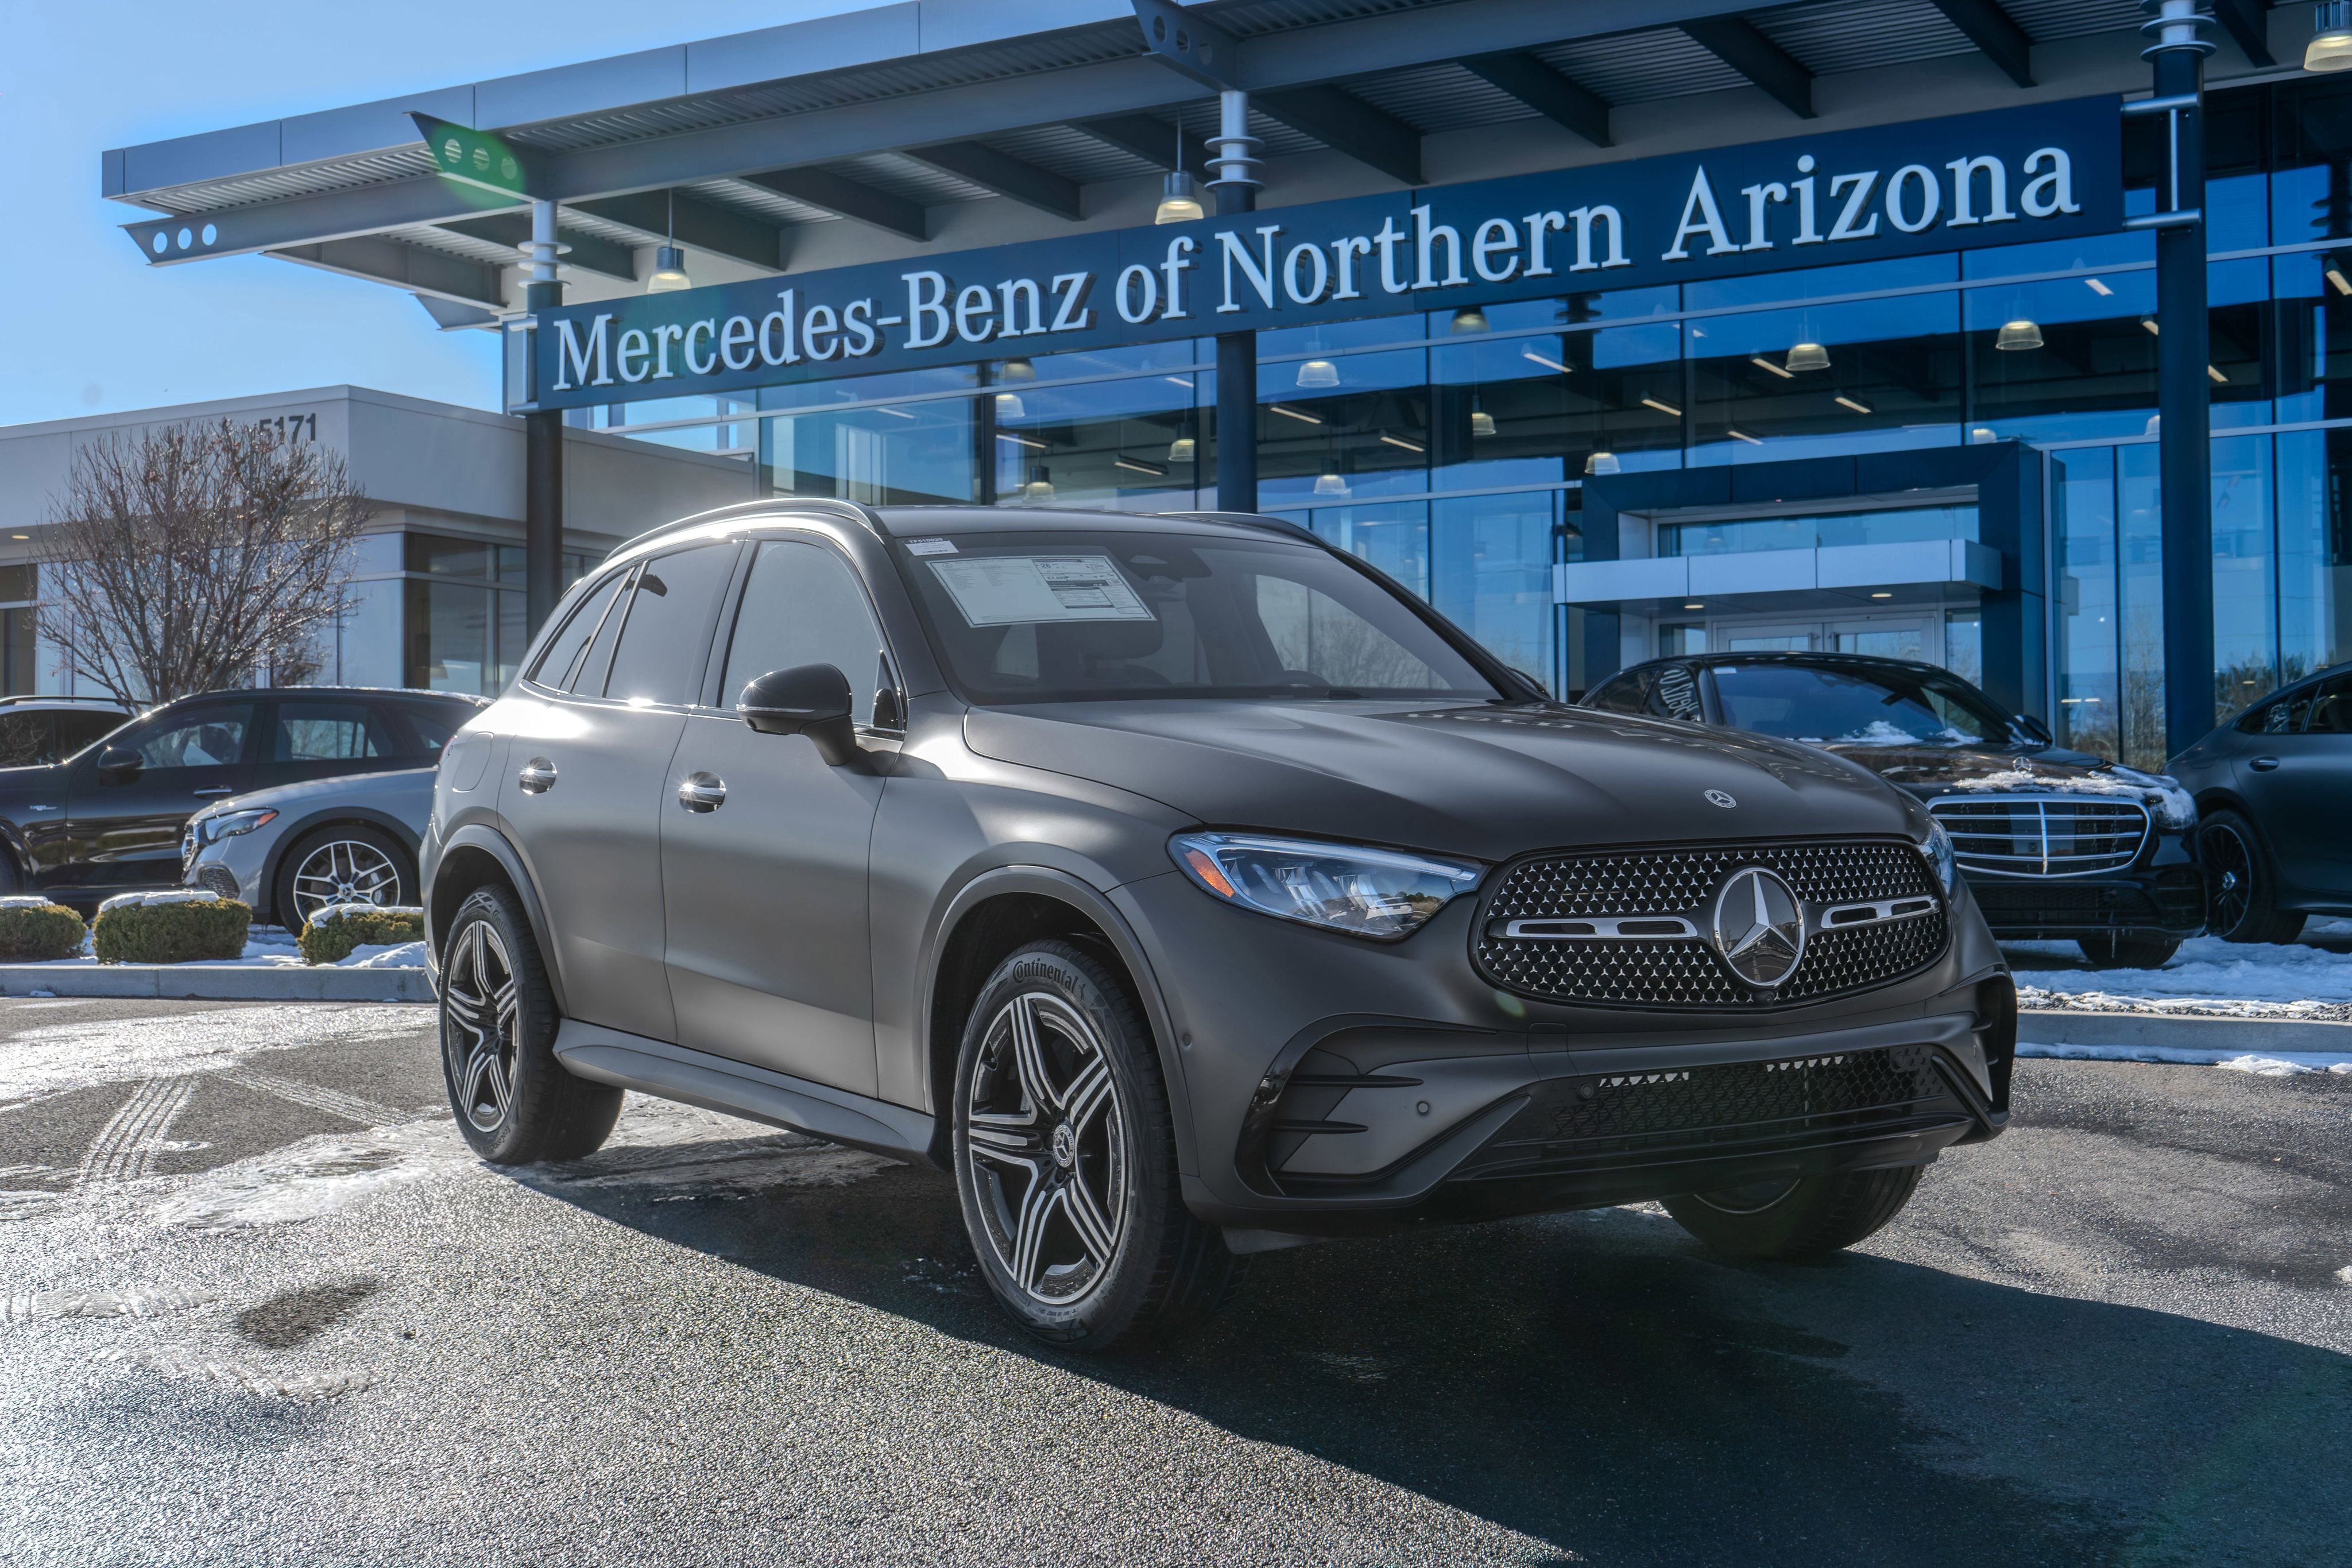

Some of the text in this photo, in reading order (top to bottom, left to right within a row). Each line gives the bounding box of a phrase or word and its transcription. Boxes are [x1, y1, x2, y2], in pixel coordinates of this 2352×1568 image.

[553, 147, 2080, 391] Mercedes-Benz of Northern Arizona
[260, 413, 315, 446] 5171
[1012, 958, 1079, 994] Continental
